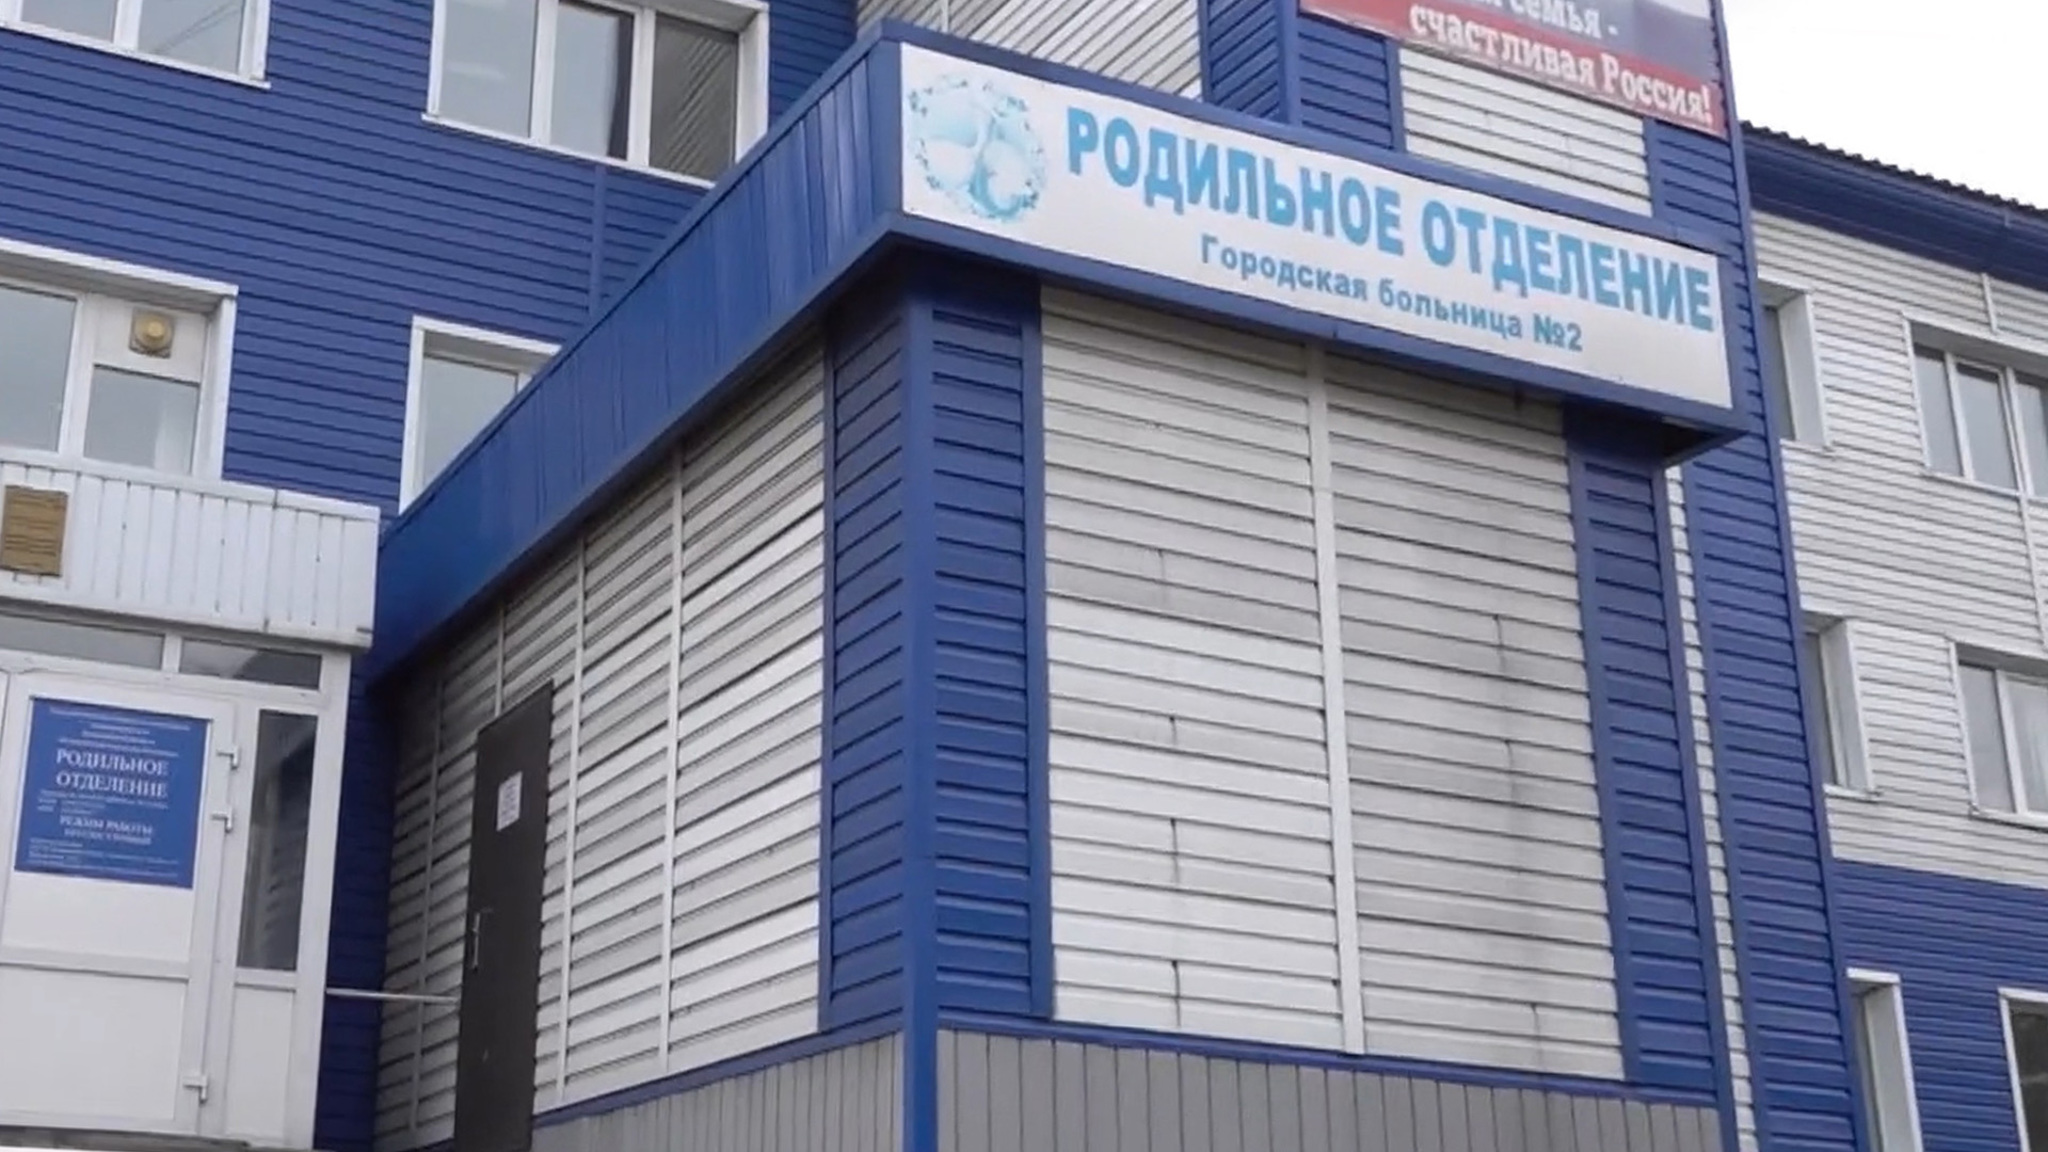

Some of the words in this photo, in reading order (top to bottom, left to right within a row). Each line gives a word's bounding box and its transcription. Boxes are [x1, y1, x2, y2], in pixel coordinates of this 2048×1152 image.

[1409, 5, 1596, 84] счастливая
[1601, 53, 1713, 123] Россия!
[1067, 106, 1405, 256] РОДИЛЬНОЕ
[1421, 199, 1714, 333] ОТДЕЛЕНИЕ
[1201, 232, 1368, 301] Городская
[1378, 278, 1523, 340] больница
[1532, 312, 1583, 352] №2
[55, 748, 170, 777] РОДИЛЬНОЕ
[55, 770, 169, 798] ОТДЕЛЕНИЕ
[105, 819, 154, 836] РАБОТЫ
